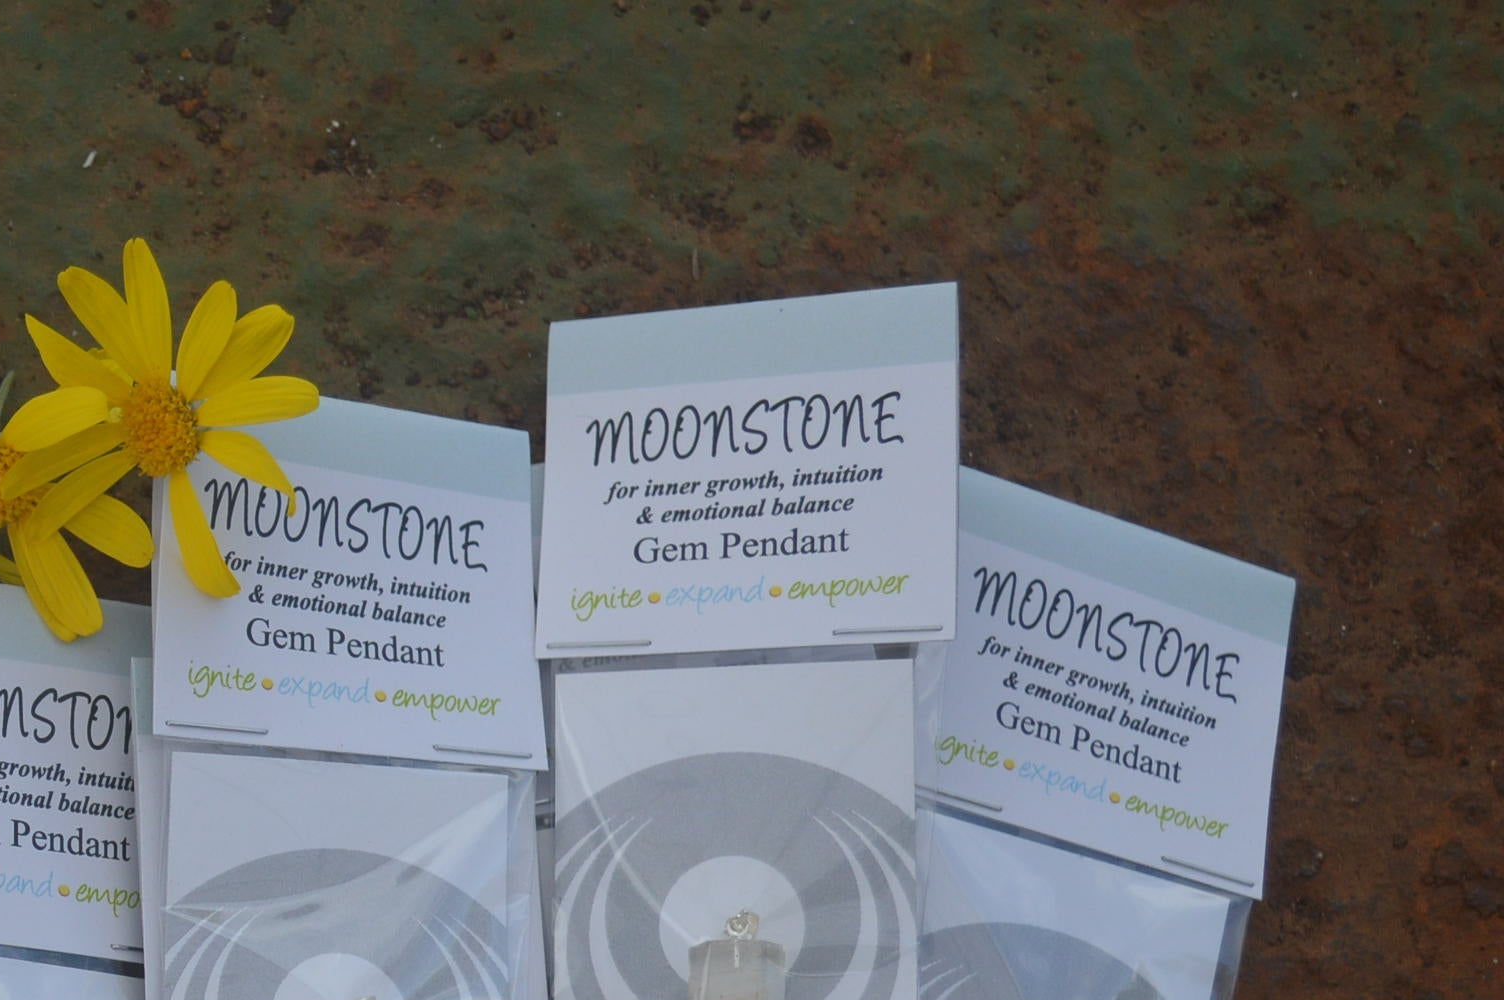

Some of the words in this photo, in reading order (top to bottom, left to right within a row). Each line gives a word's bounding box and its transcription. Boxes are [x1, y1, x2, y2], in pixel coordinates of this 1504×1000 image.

[586, 391, 904, 466] MOONSTONE
[604, 482, 638, 504] for
[645, 480, 701, 497] inner
[706, 474, 785, 498] growth,
[792, 465, 883, 487] intuition
[636, 507, 654, 524] &
[661, 500, 765, 523] emotional
[771, 496, 854, 516] balance
[204, 478, 487, 572] MOONSTONE
[633, 537, 709, 564] Gem
[720, 528, 849, 559] Pendant
[223, 551, 252, 572] for
[257, 556, 309, 581] inner
[312, 570, 384, 594] growth,
[390, 578, 471, 604] intuition
[571, 587, 643, 621] ignite
[665, 576, 765, 614] expand
[787, 575, 910, 607] empower
[248, 585, 265, 603] &
[271, 588, 366, 618] emotional
[372, 603, 447, 628] balance
[246, 617, 317, 653] Gem
[327, 629, 445, 667] Pendant
[973, 566, 1240, 703] MOONSTONE
[188, 660, 257, 698] ignite
[278, 674, 371, 708] expand
[392, 688, 502, 721] empower
[978, 636, 1010, 657] for
[1014, 646, 1064, 678] inner
[1066, 668, 1135, 704] growth,
[1141, 690, 1218, 729] intuition
[1003, 672, 1019, 690] &
[1025, 680, 1117, 723] emotional
[1119, 710, 1190, 747] balance
[996, 701, 1062, 745] Gem
[1071, 725, 1182, 784] Pendant
[58, 796, 135, 821] balance
[1019, 758, 1110, 803] expand
[1124, 794, 1229, 838] empower
[11, 819, 131, 862] Pendant
[75, 883, 141, 917] empo
